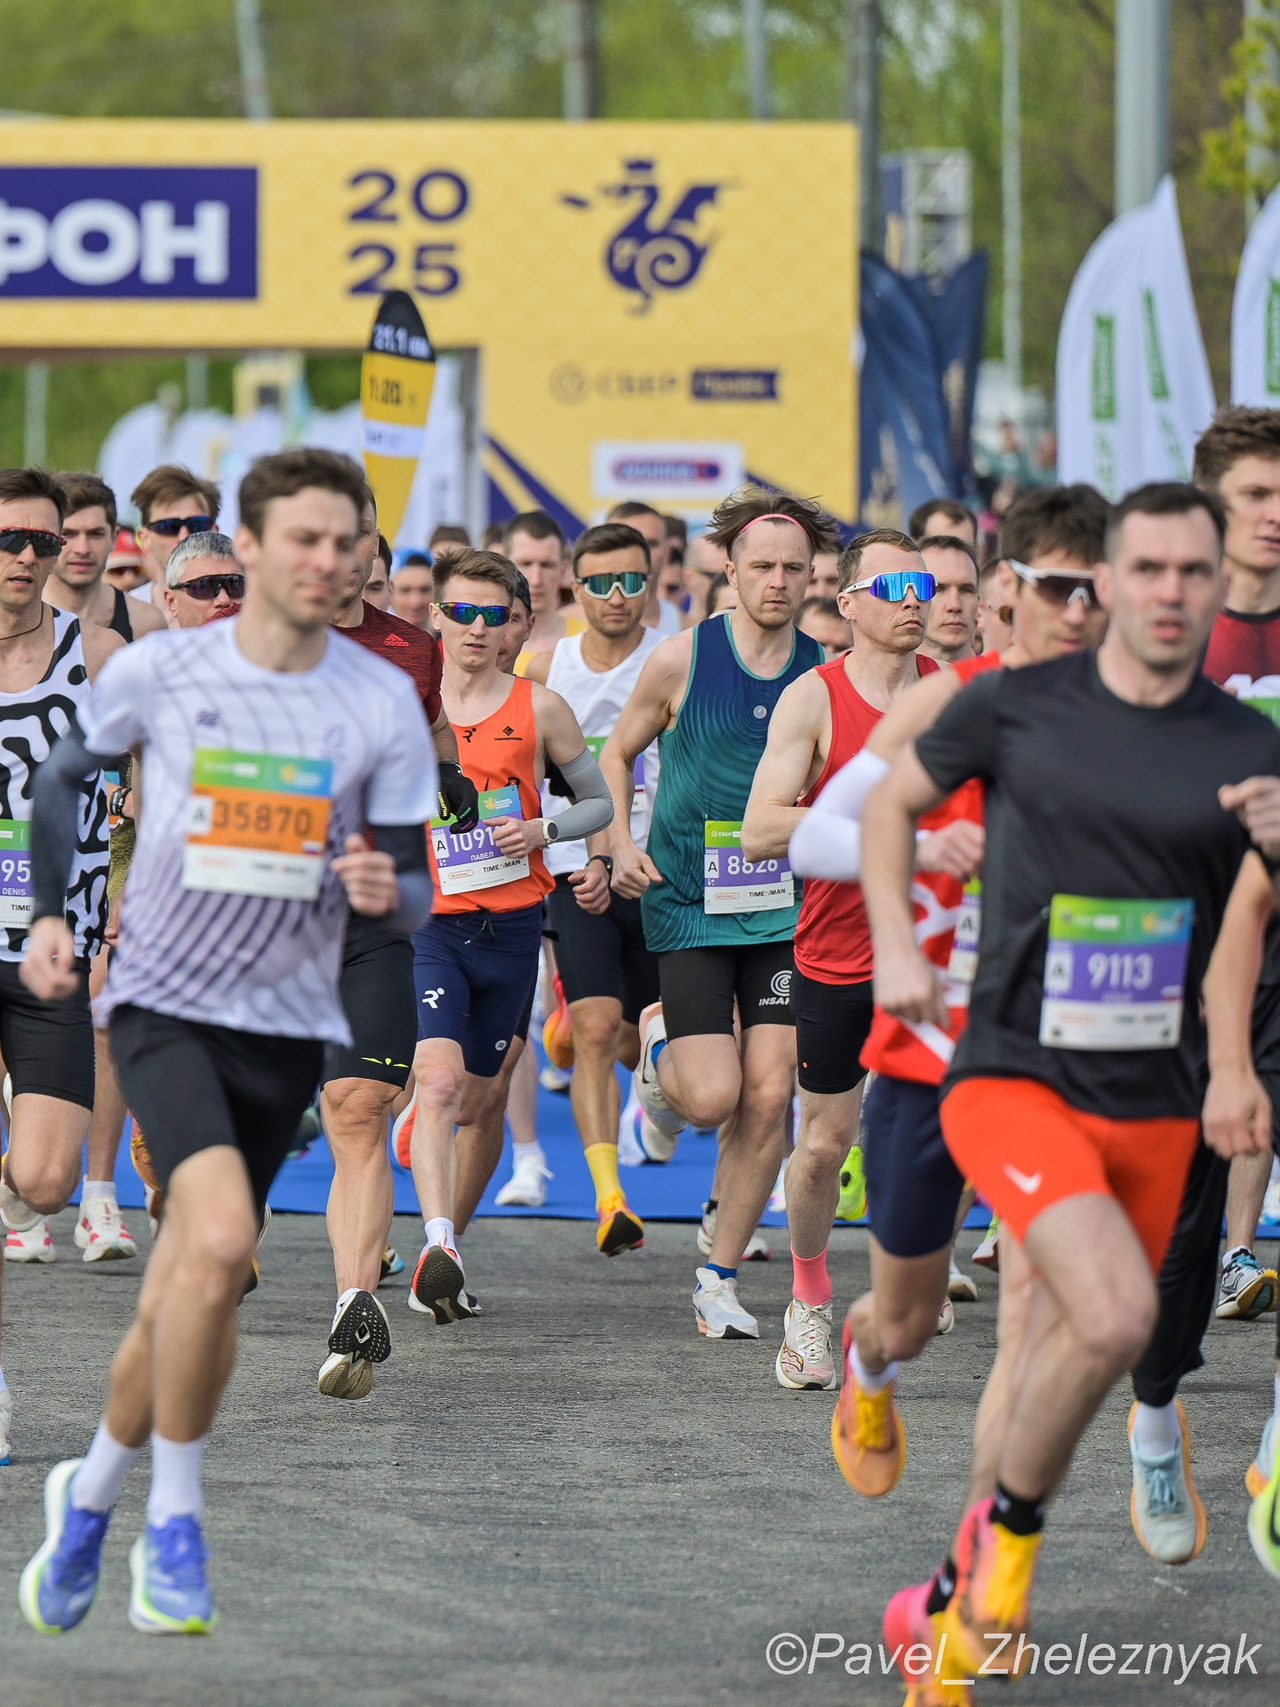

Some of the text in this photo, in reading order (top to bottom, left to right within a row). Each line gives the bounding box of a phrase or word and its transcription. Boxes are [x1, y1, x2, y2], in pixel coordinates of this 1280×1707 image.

[349, 169, 469, 223] 20
[349, 243, 460, 297] 25
[192, 800, 313, 837] A 35870
[436, 840, 446, 852] A
[470, 851, 495, 862] ПАВЕЛ
[707, 861, 718, 872] A
[1, 887, 27, 896] DENIS
[1087, 952, 1154, 990] 9113
